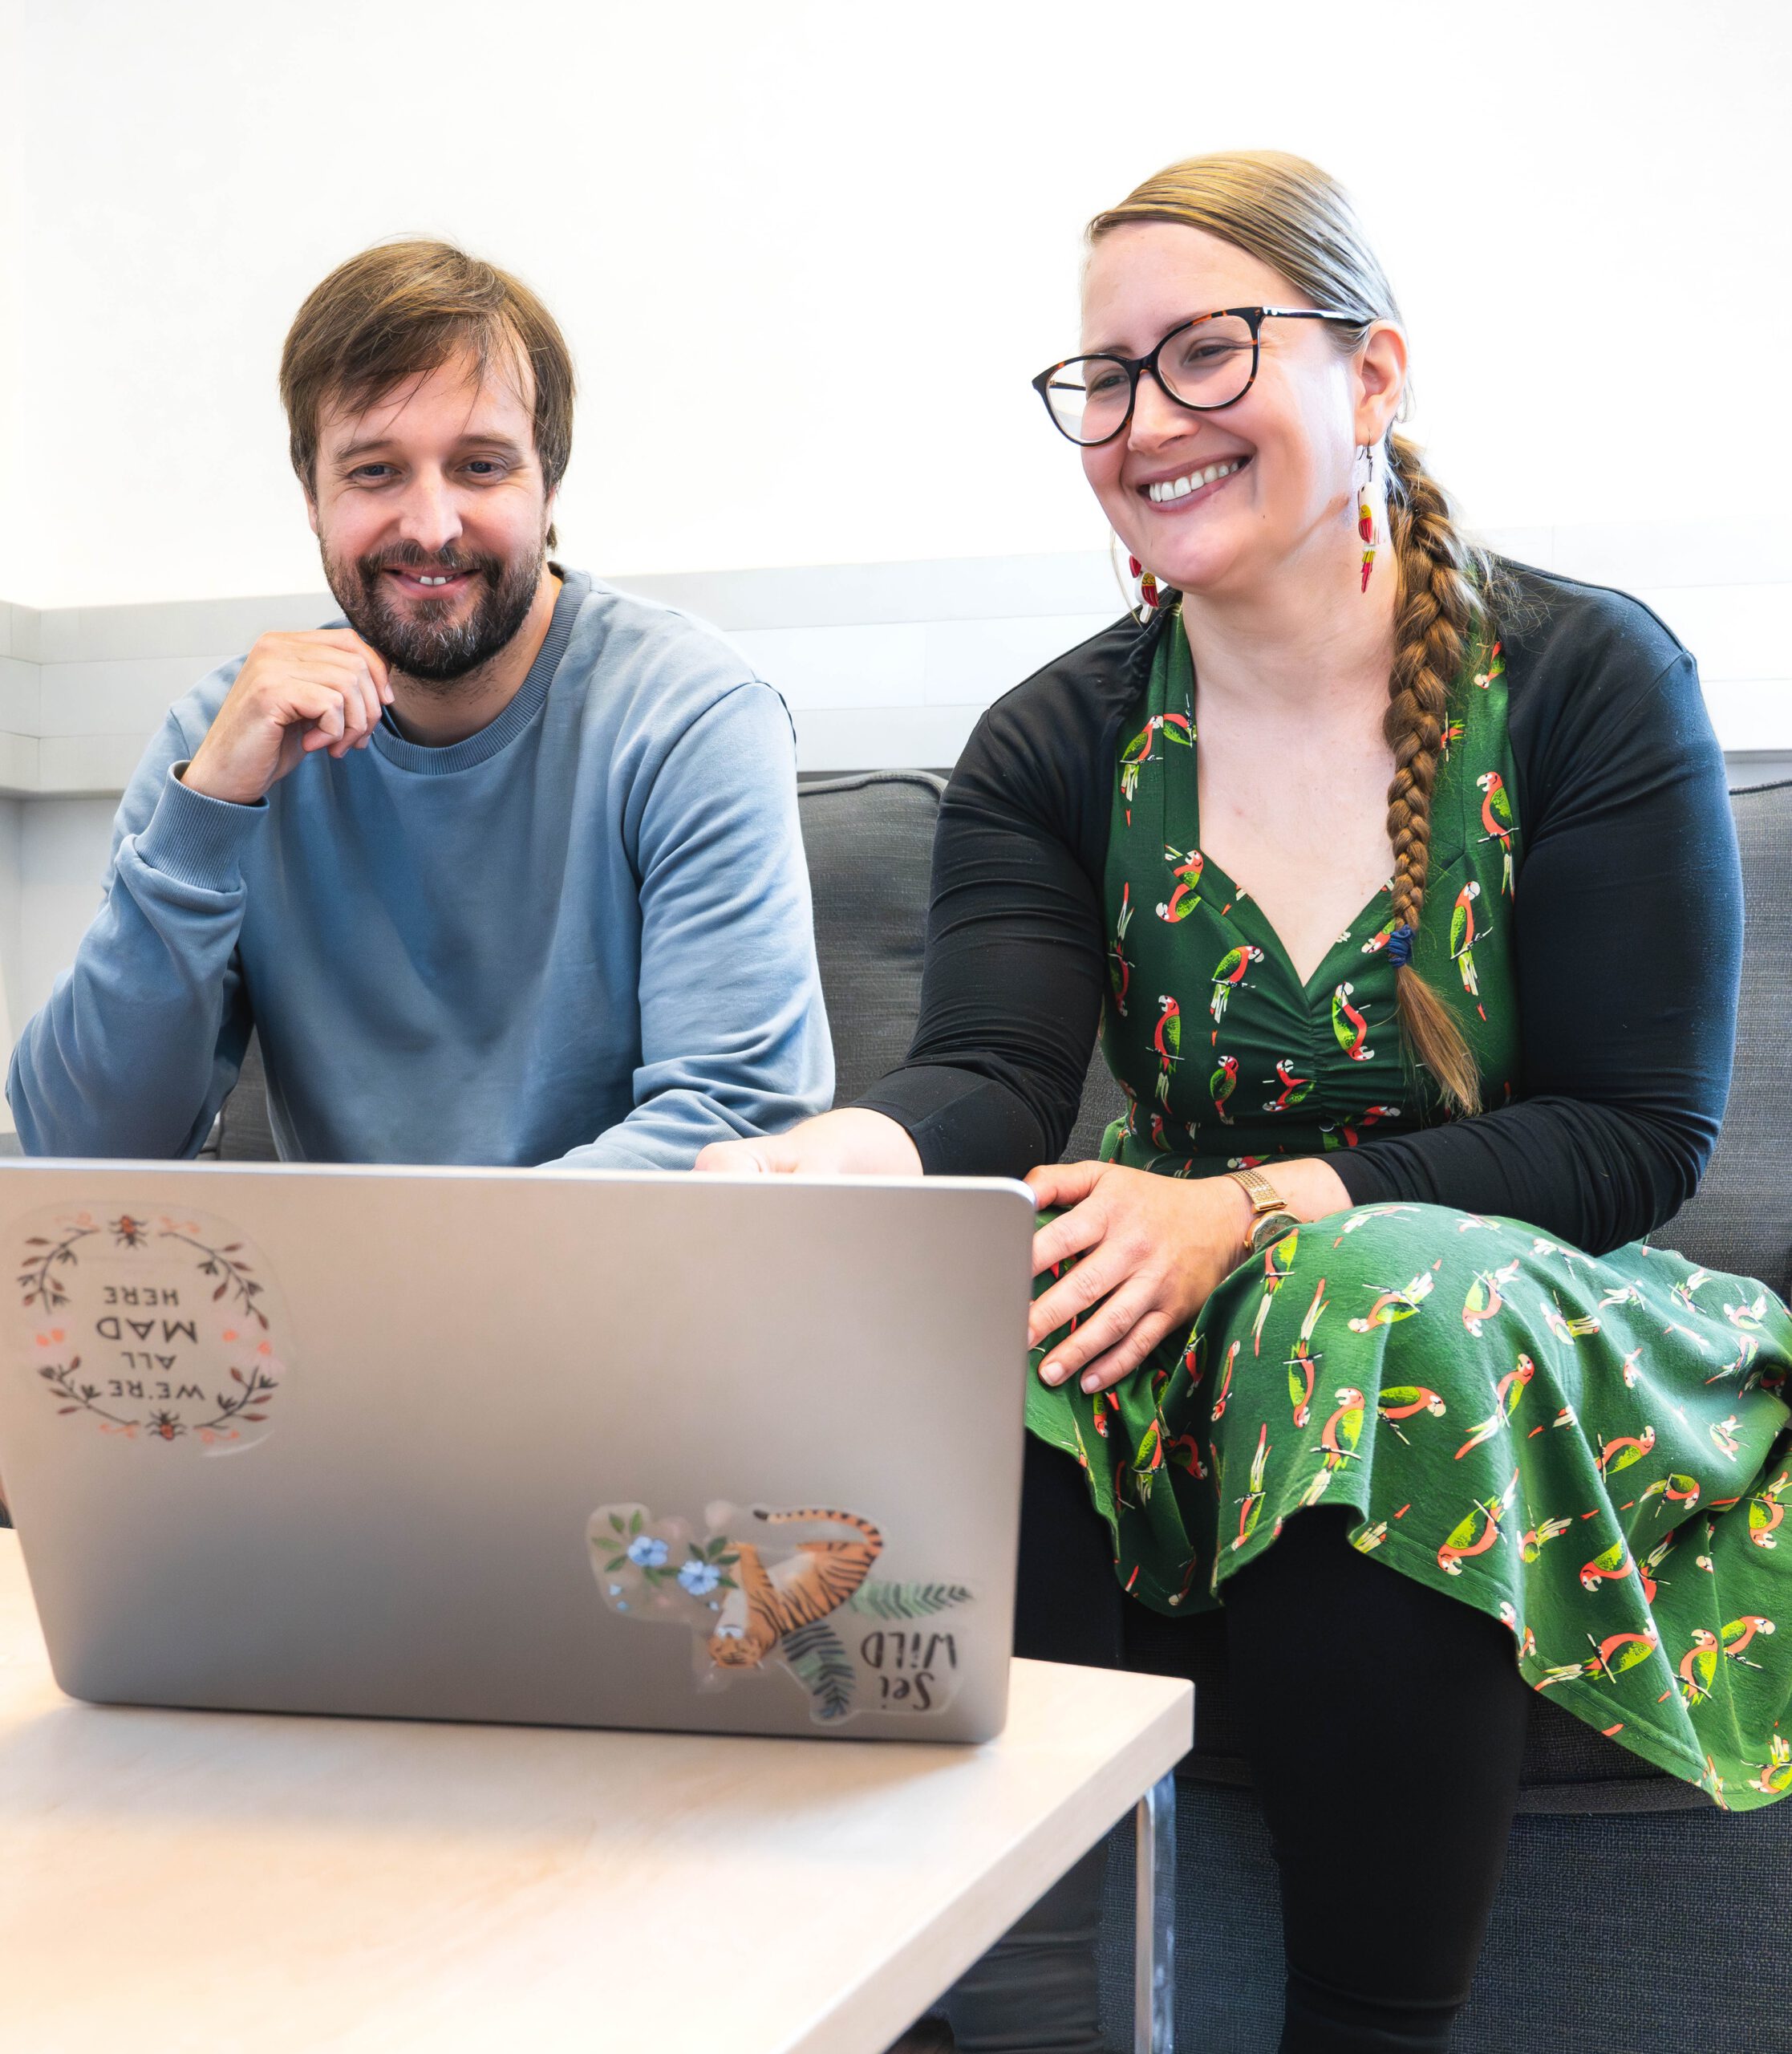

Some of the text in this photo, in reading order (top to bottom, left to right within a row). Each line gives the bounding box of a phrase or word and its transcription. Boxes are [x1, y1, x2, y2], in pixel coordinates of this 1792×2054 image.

[103, 1286, 180, 1306] HERE
[96, 1317, 198, 1344] MAD
[121, 1351, 177, 1370] ALL
[879, 1671, 935, 1711] Sei
